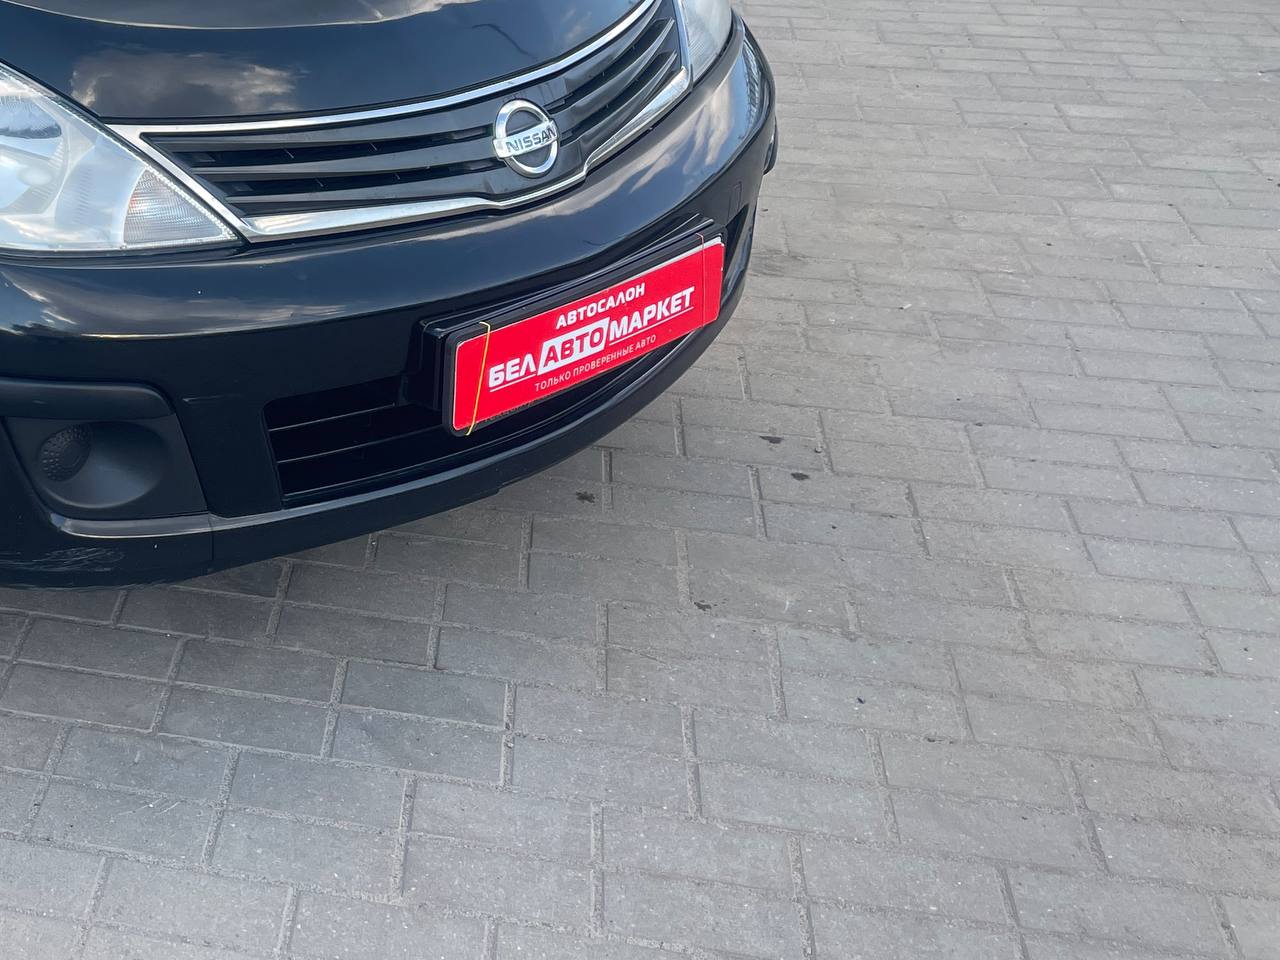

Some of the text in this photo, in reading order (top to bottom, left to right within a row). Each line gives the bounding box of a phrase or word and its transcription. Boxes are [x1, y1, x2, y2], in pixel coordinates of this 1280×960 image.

[505, 125, 556, 153] NISSAN
[555, 282, 646, 330] АВТОСАЛОН
[534, 334, 657, 392] ТОЛЬКО ПРОВЕРЕННЫЕ АВТО
